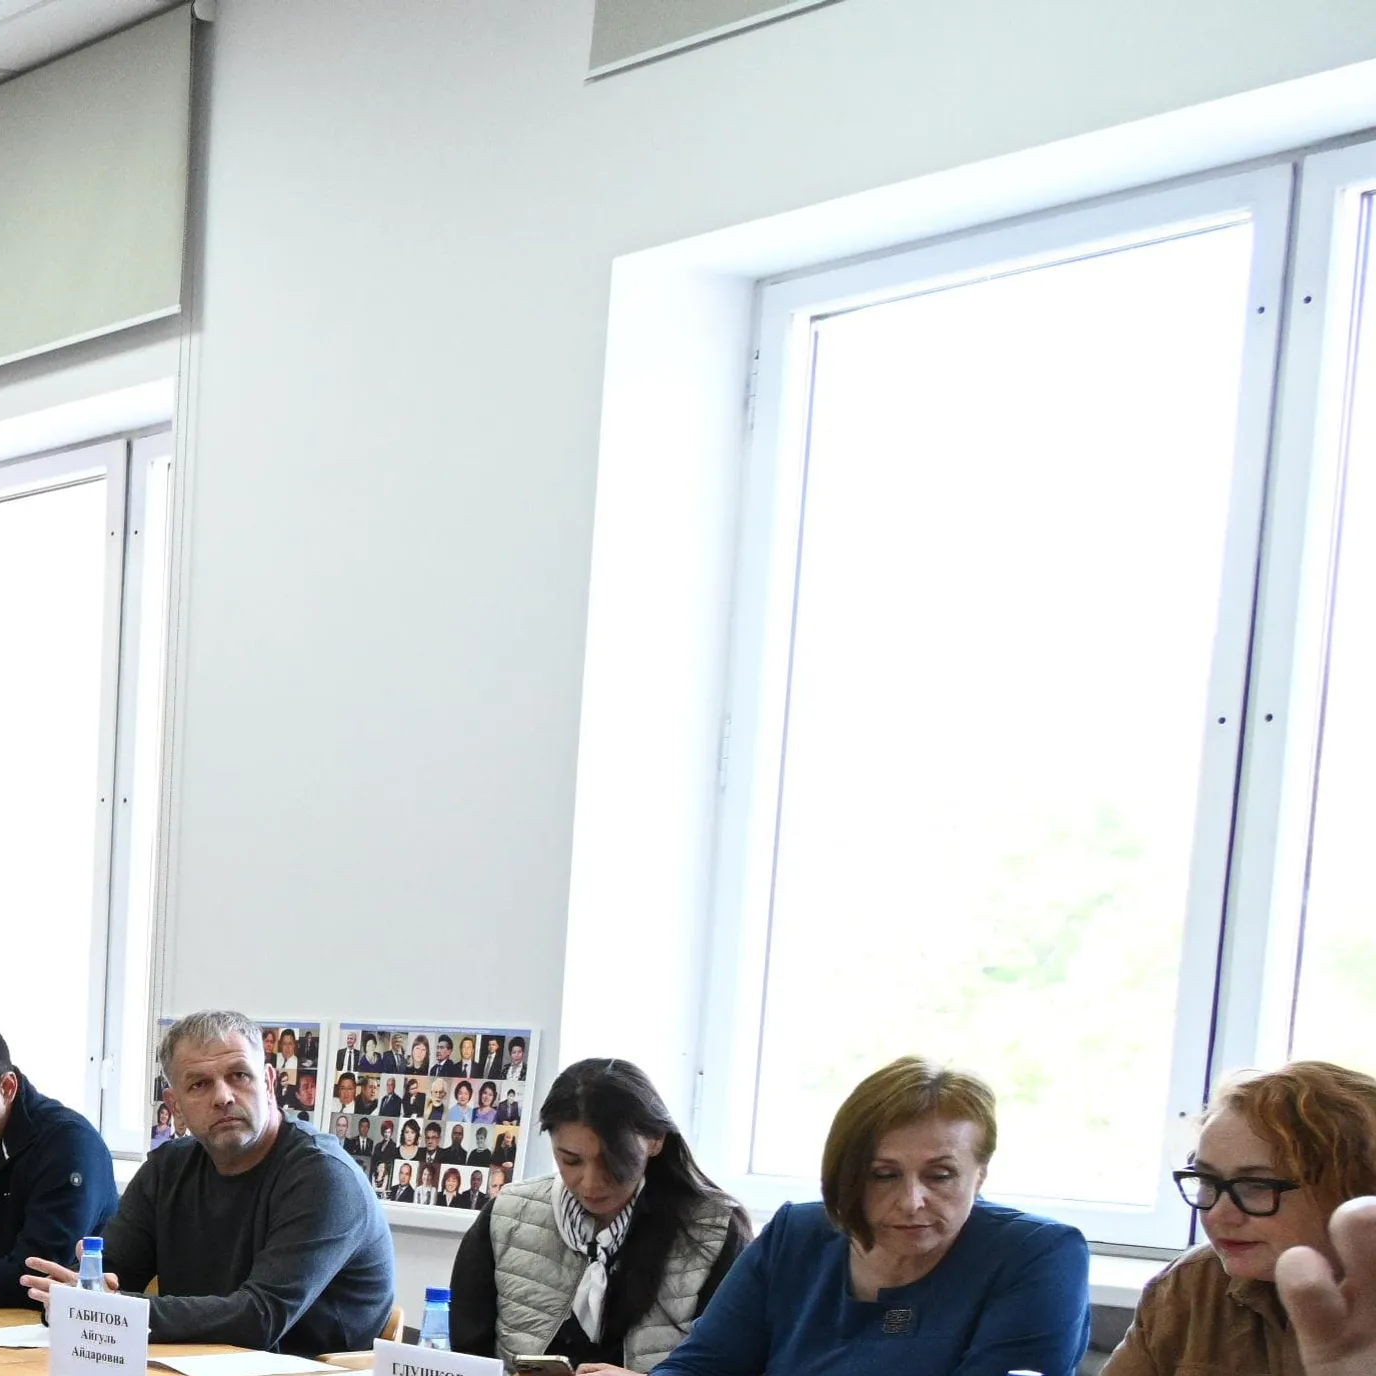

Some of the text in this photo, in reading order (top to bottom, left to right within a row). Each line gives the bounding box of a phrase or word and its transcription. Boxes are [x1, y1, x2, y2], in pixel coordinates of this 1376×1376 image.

[69, 1307, 128, 1327] ГАБИТОВА
[80, 1328, 116, 1345] Айгуль
[71, 1346, 125, 1365] Айдаровна
